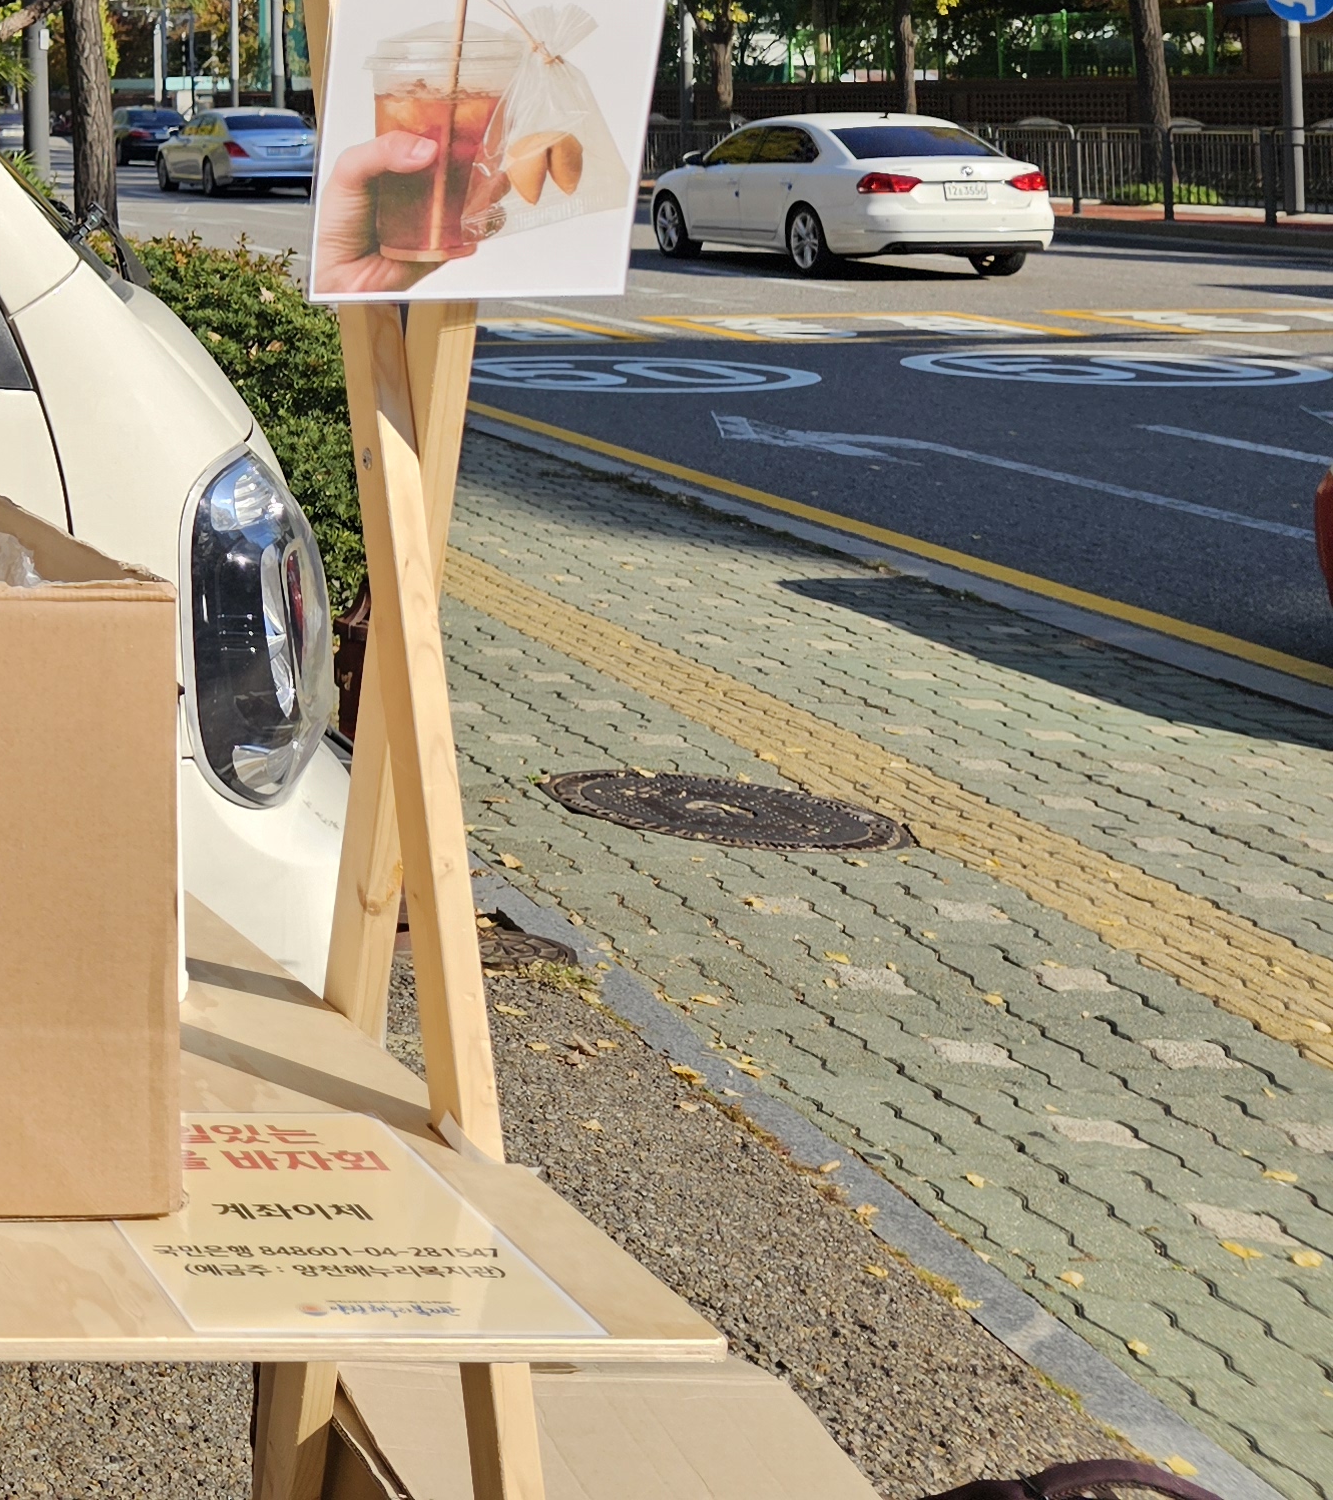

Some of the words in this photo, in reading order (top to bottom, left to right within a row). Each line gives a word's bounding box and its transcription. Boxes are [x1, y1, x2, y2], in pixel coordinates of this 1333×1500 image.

[473, 360, 767, 386] 50
[937, 355, 1276, 381] 50
[220, 1150, 391, 1171] 바자회
[211, 1203, 374, 1221] 계좌이체
[153, 1244, 253, 1258] 국민은행
[260, 1245, 499, 1258] 848601-04-281547
[292, 1264, 506, 1279] 양천해누리복지관)
